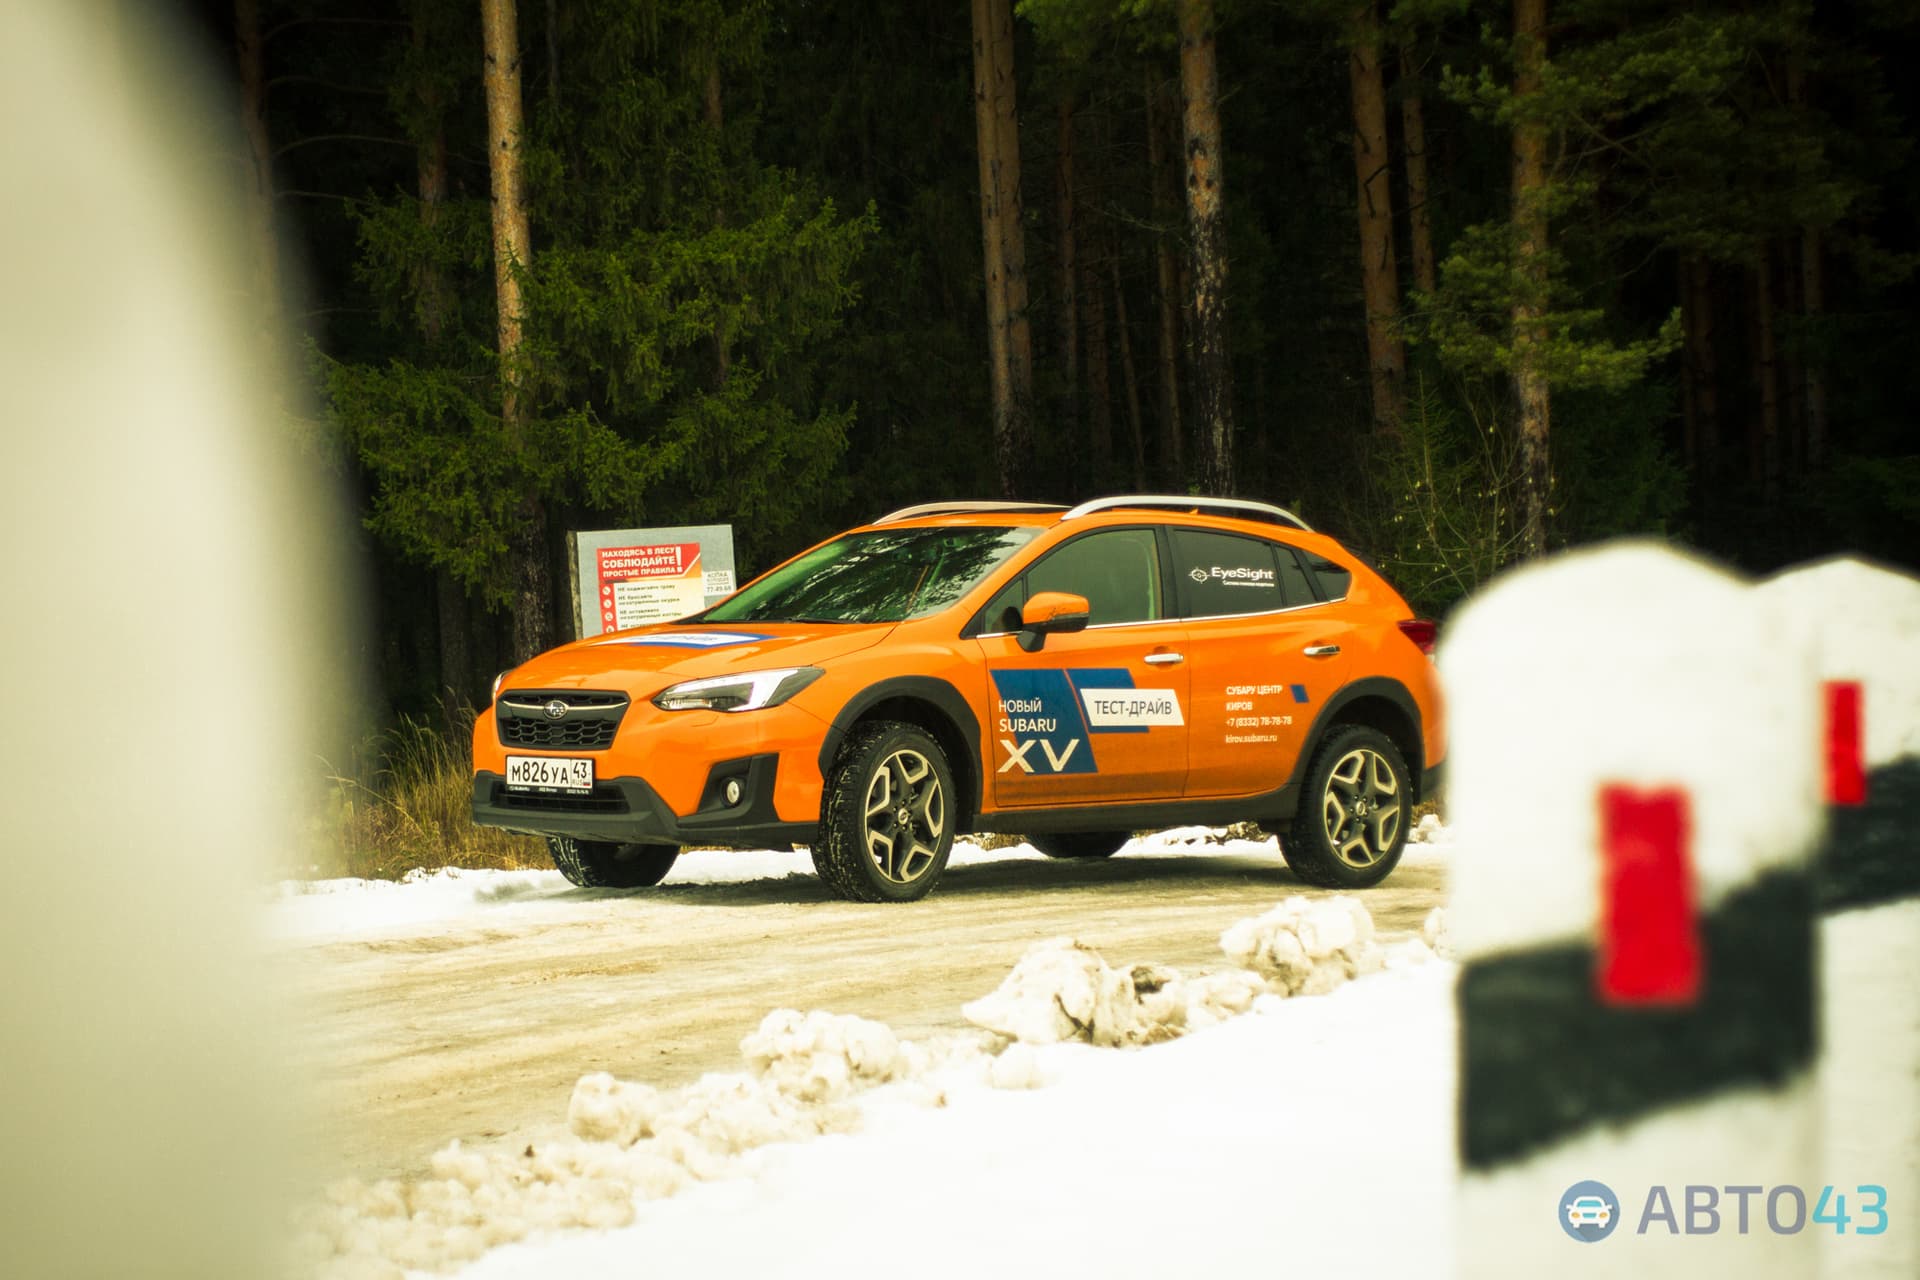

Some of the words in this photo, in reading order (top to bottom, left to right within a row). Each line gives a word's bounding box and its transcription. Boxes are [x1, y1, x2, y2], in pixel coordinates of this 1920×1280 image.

[602, 549, 645, 557] НАХОДЯСЬ
[602, 555, 676, 569] СОБЛЮДАЙТЕ
[603, 569, 639, 577] ПРОСТЫЕ
[640, 567, 675, 575] ПРАВИЛА
[1211, 567, 1273, 580] EyeSight
[1226, 686, 1256, 695] СУБАРУ
[1257, 685, 1283, 695] ЦЕНТР
[998, 697, 1042, 713] НОВЫЙ
[1094, 698, 1173, 717] ТЕСТ-ДРАЙВ
[1226, 701, 1253, 711] КИРОВ
[999, 718, 1057, 732] SUBARU
[1226, 718, 1235, 727] +7
[1236, 717, 1259, 728] (8332)
[1260, 716, 1292, 725] 78-78-78
[1225, 733, 1278, 743] kirov.subaru.ru
[997, 739, 1080, 773] XV
[573, 762, 587, 778] 43
